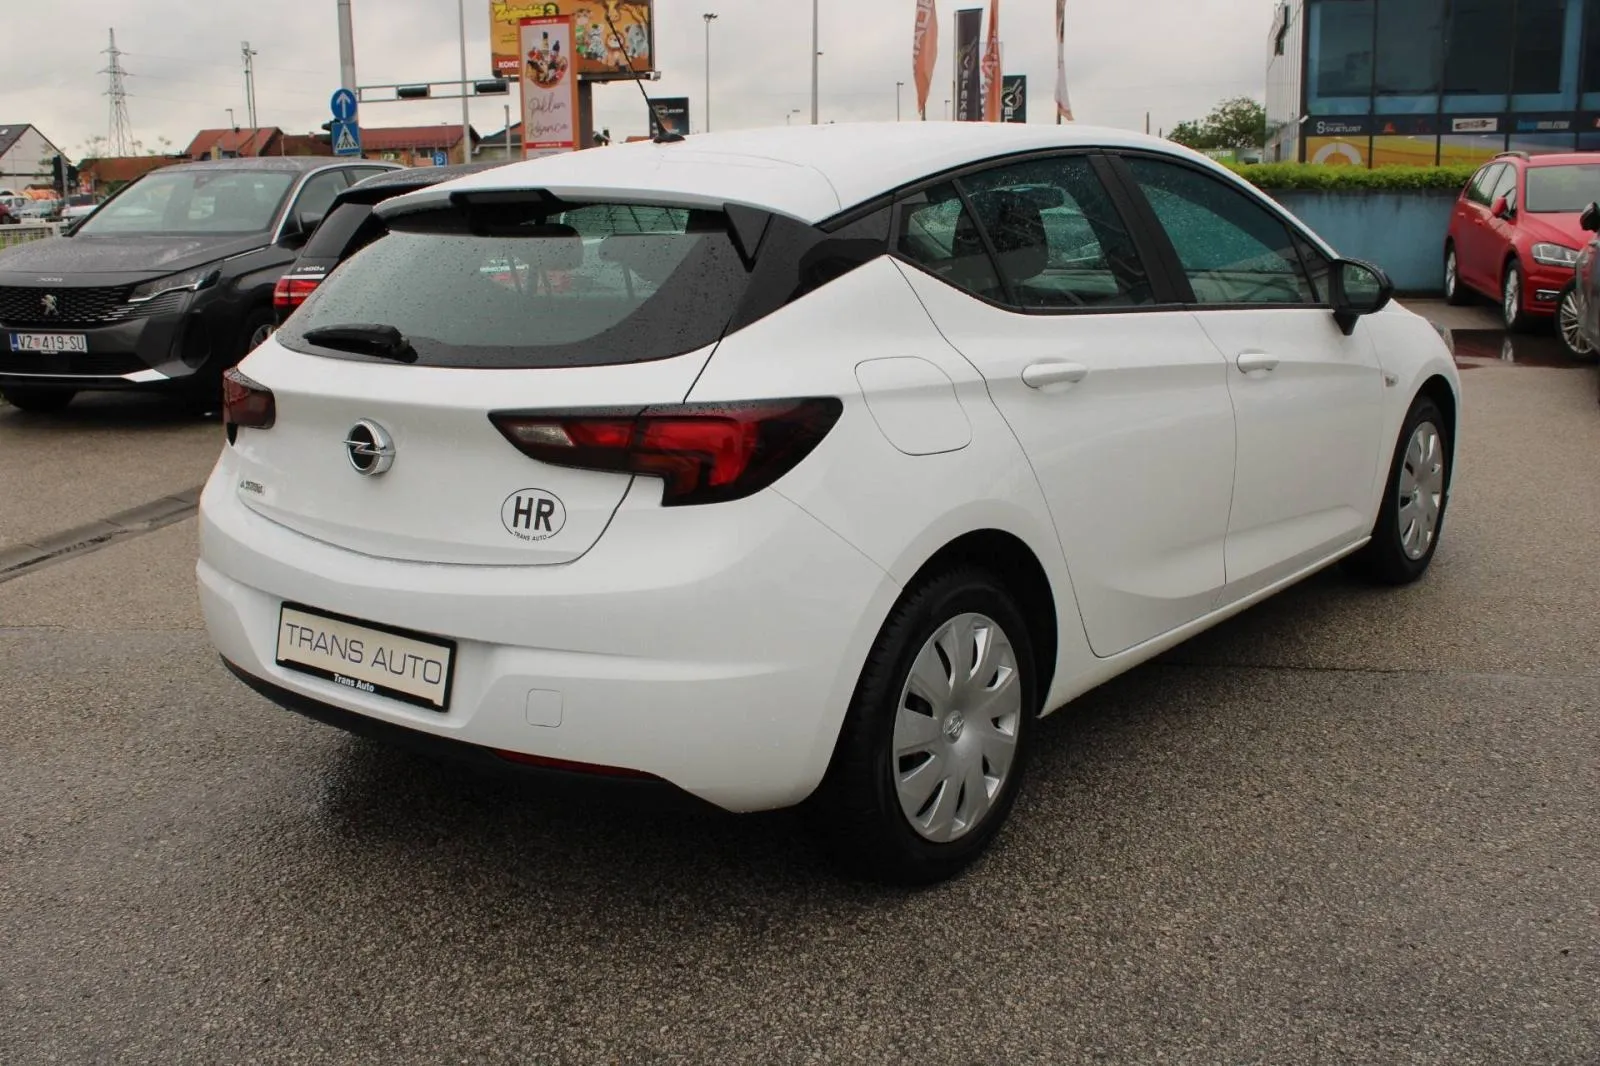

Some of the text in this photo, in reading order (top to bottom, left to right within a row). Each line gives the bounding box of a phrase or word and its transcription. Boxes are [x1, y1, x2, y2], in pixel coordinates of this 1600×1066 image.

[18, 335, 33, 349] VZ
[513, 496, 555, 532] HR
[513, 531, 548, 542] TRANS AUTO
[285, 622, 443, 685] TRANS AUTO
[333, 673, 375, 693] Trans Auto
